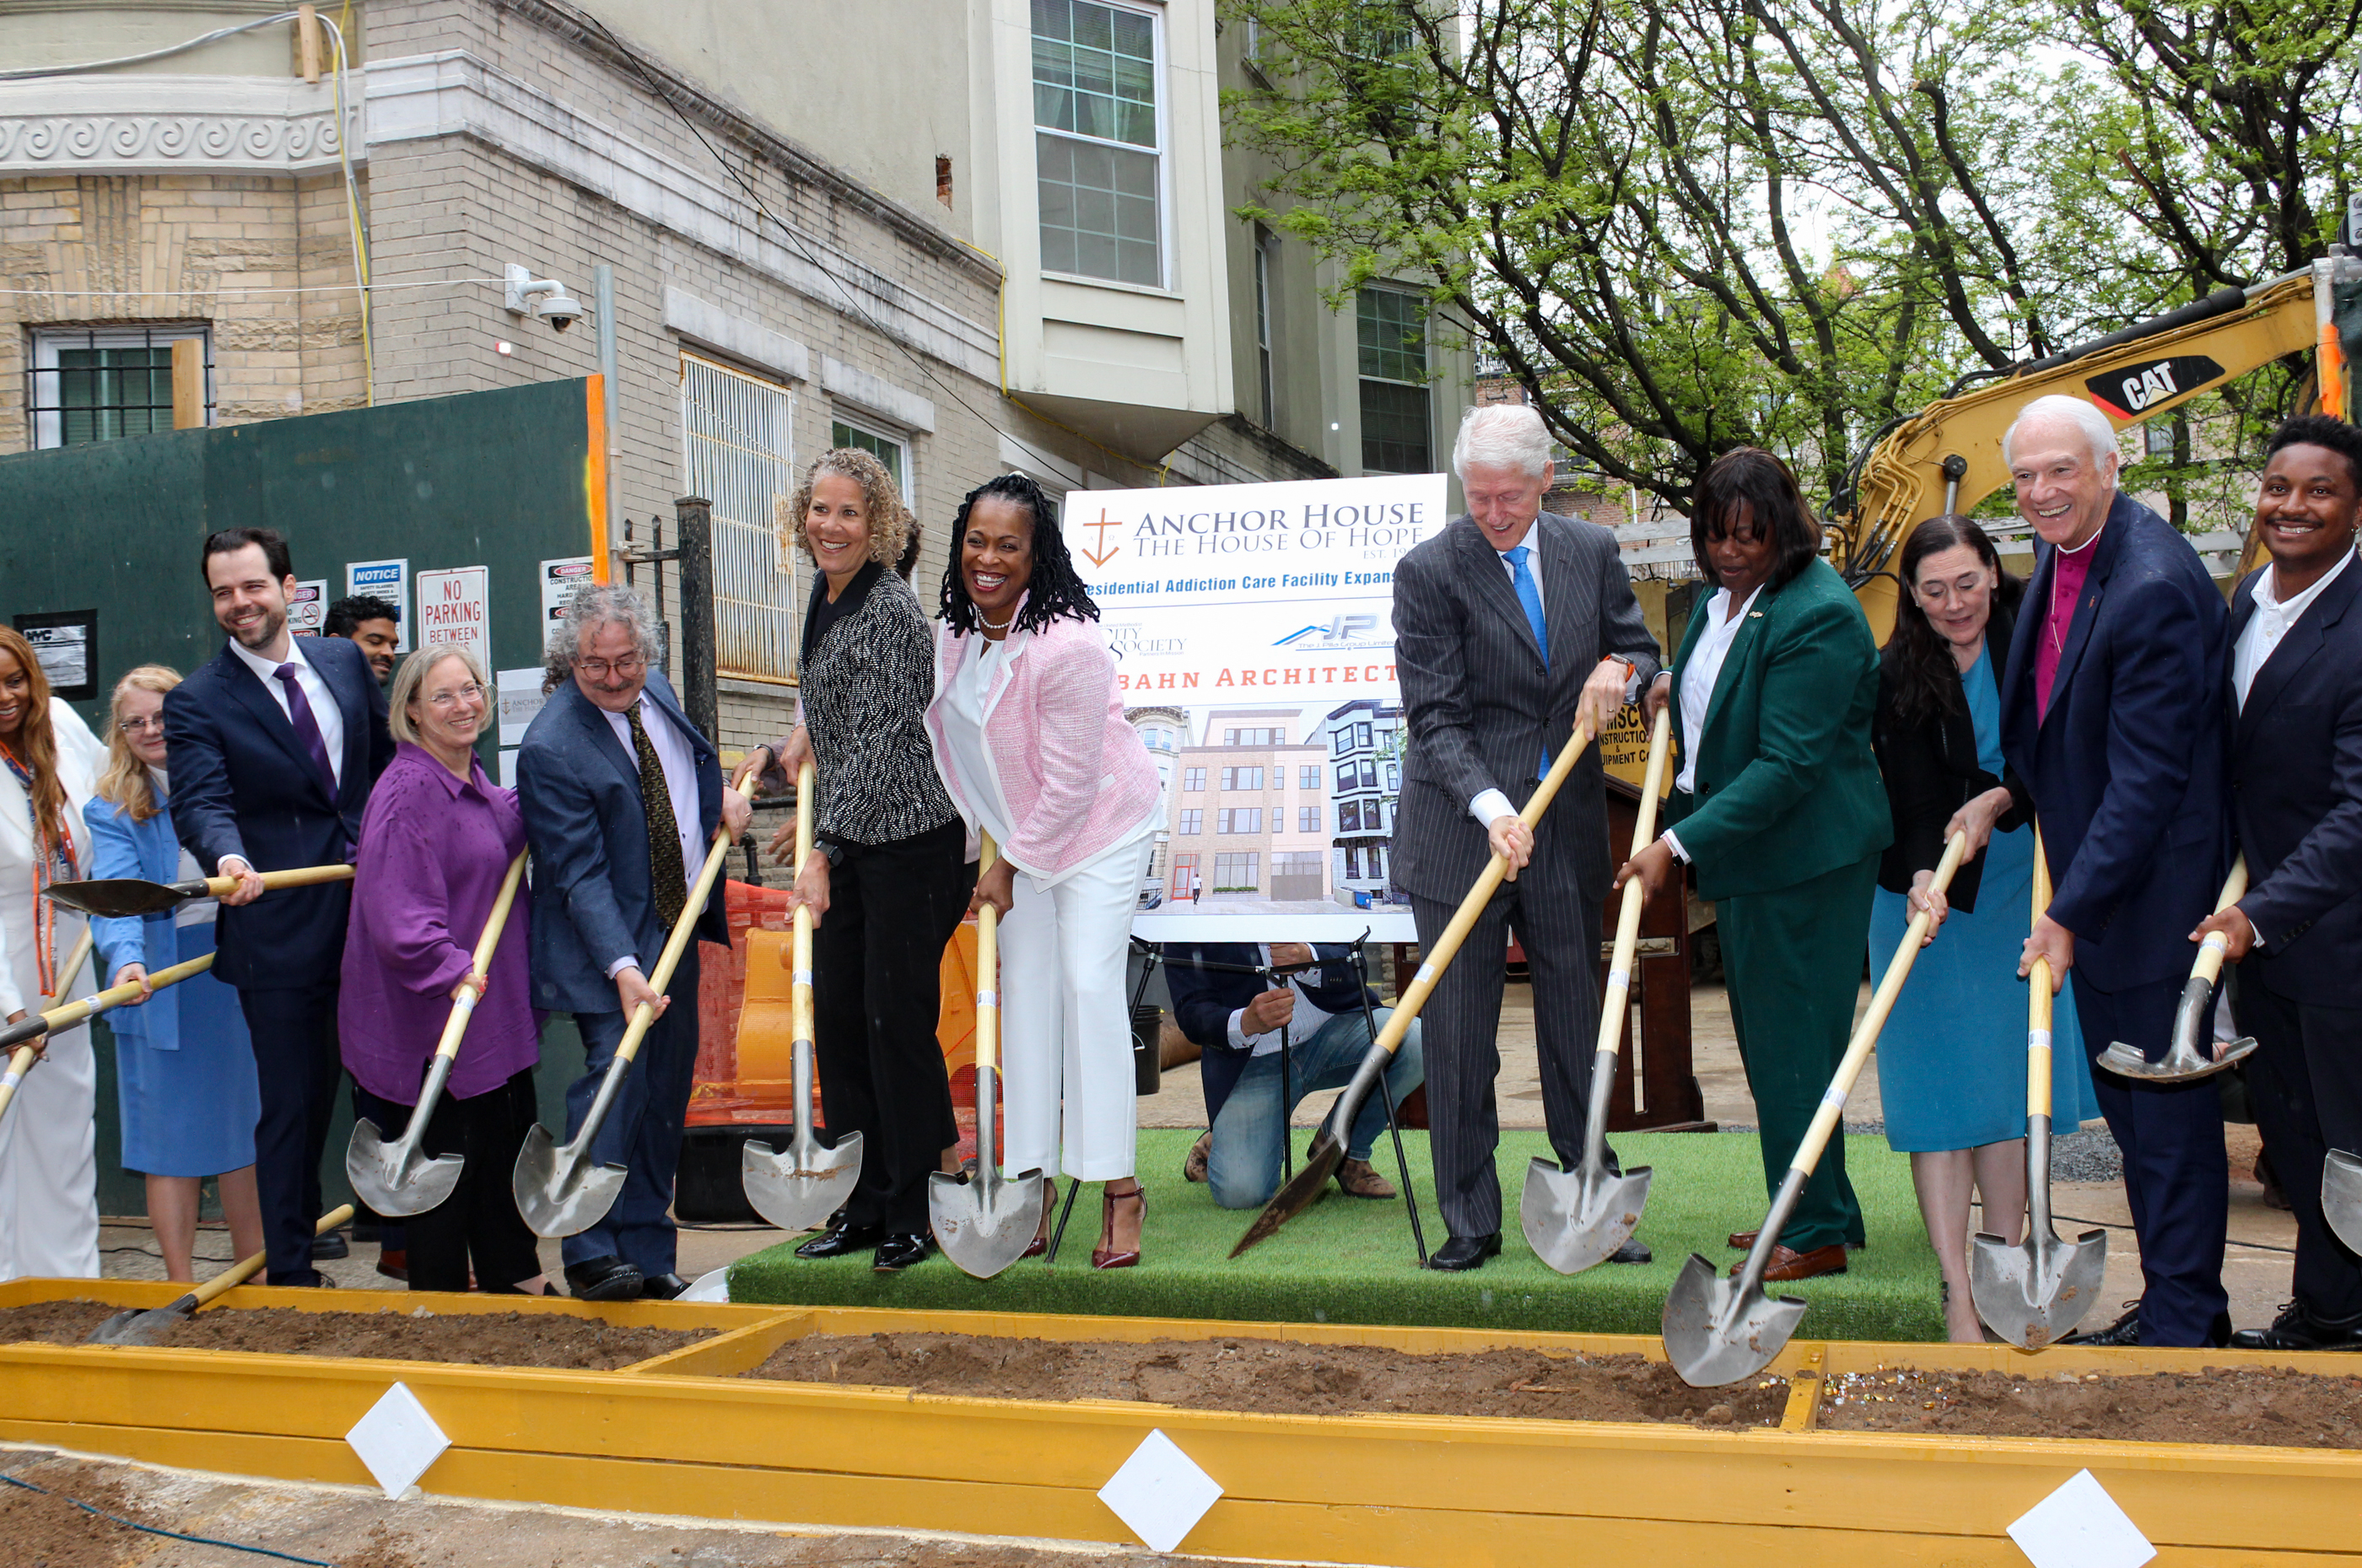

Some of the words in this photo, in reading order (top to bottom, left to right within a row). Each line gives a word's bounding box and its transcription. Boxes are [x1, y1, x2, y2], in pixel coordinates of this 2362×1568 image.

[2122, 361, 2178, 410] CAT
[1133, 509, 1291, 536] ANCHOR
[1302, 503, 1424, 529] HOUSE
[1133, 537, 1185, 557] THE
[1198, 534, 1288, 554] HOUSE
[1300, 529, 1336, 549] OF
[1349, 527, 1423, 547] HOPE
[1363, 549, 1387, 559] EST.
[1393, 547, 1412, 558] 19
[356, 568, 399, 582] NOTICE
[1165, 578, 1237, 593] Addiction
[1243, 575, 1276, 589] Care
[1282, 573, 1339, 587] Facility
[444, 579, 461, 601] NO
[425, 601, 481, 625] PARKING
[26, 630, 52, 641] NYC
[429, 627, 478, 643] BETWEEN
[1323, 614, 1378, 640] JP
[1108, 639, 1187, 664] SOCIETY
[512, 698, 544, 707] ANCHOR
[1599, 730, 1649, 746] NSTRUCTIO
[1615, 745, 1621, 753] &
